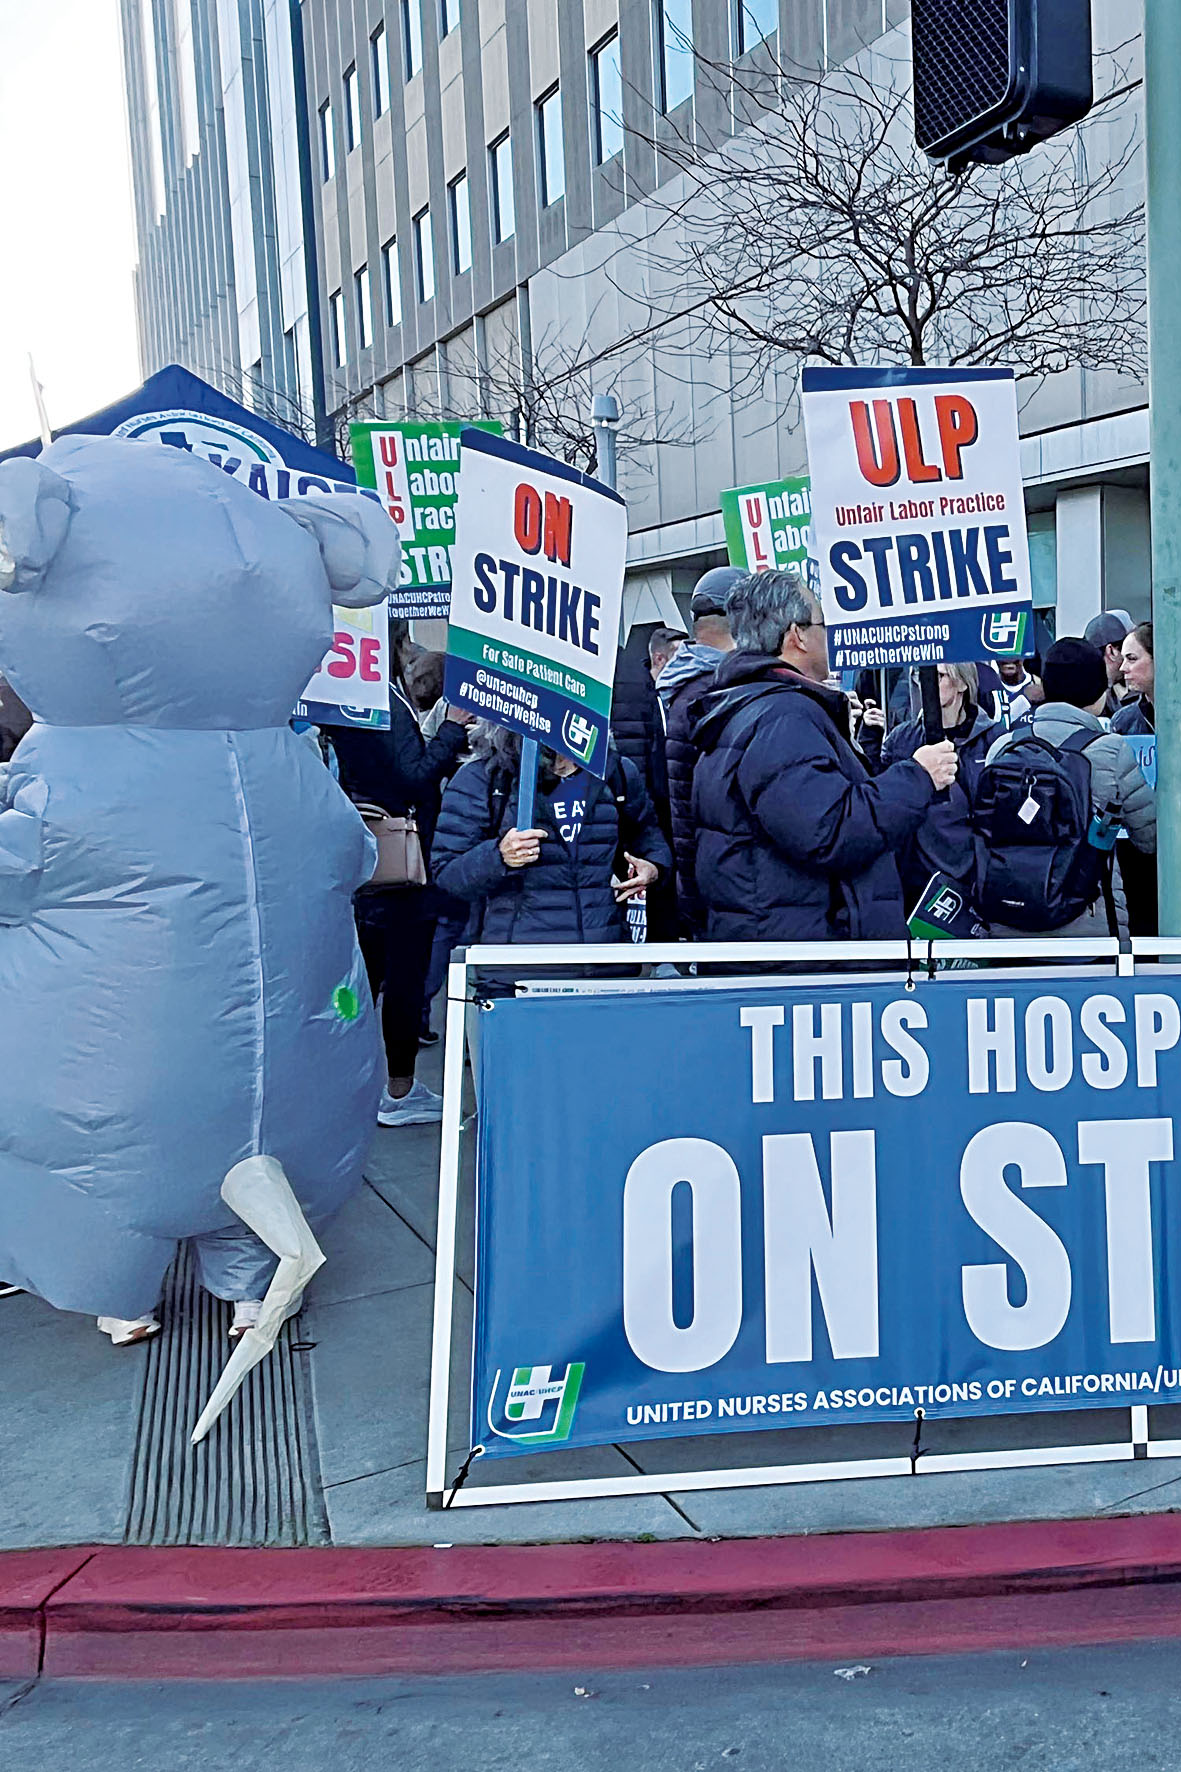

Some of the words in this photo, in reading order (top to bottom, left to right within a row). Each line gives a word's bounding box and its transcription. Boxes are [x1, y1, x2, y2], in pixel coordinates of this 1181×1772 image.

[849, 394, 979, 488] ULP
[514, 482, 574, 569] ON
[836, 502, 884, 526] Unfair
[890, 500, 934, 521] Labor
[939, 492, 1005, 515] Practice
[830, 525, 1017, 612] STRIKE
[473, 552, 601, 657] STRIKE
[834, 624, 950, 646] #UNACUHCPstrong
[836, 643, 944, 667] #TogetherWeWin
[476, 669, 538, 709] @unacuhcp
[482, 644, 499, 664] For
[501, 651, 524, 672] Safe
[526, 660, 563, 687] Patient
[565, 674, 586, 697] Care
[460, 682, 552, 733] #TogetherWeRise
[740, 1000, 930, 1103] THIS
[622, 1128, 881, 1374] ON
[626, 1399, 713, 1426] UNITED
[718, 1393, 807, 1418] NURSES
[813, 1382, 982, 1410] ASSOCIATIONS
[986, 1379, 1017, 1399] OF
